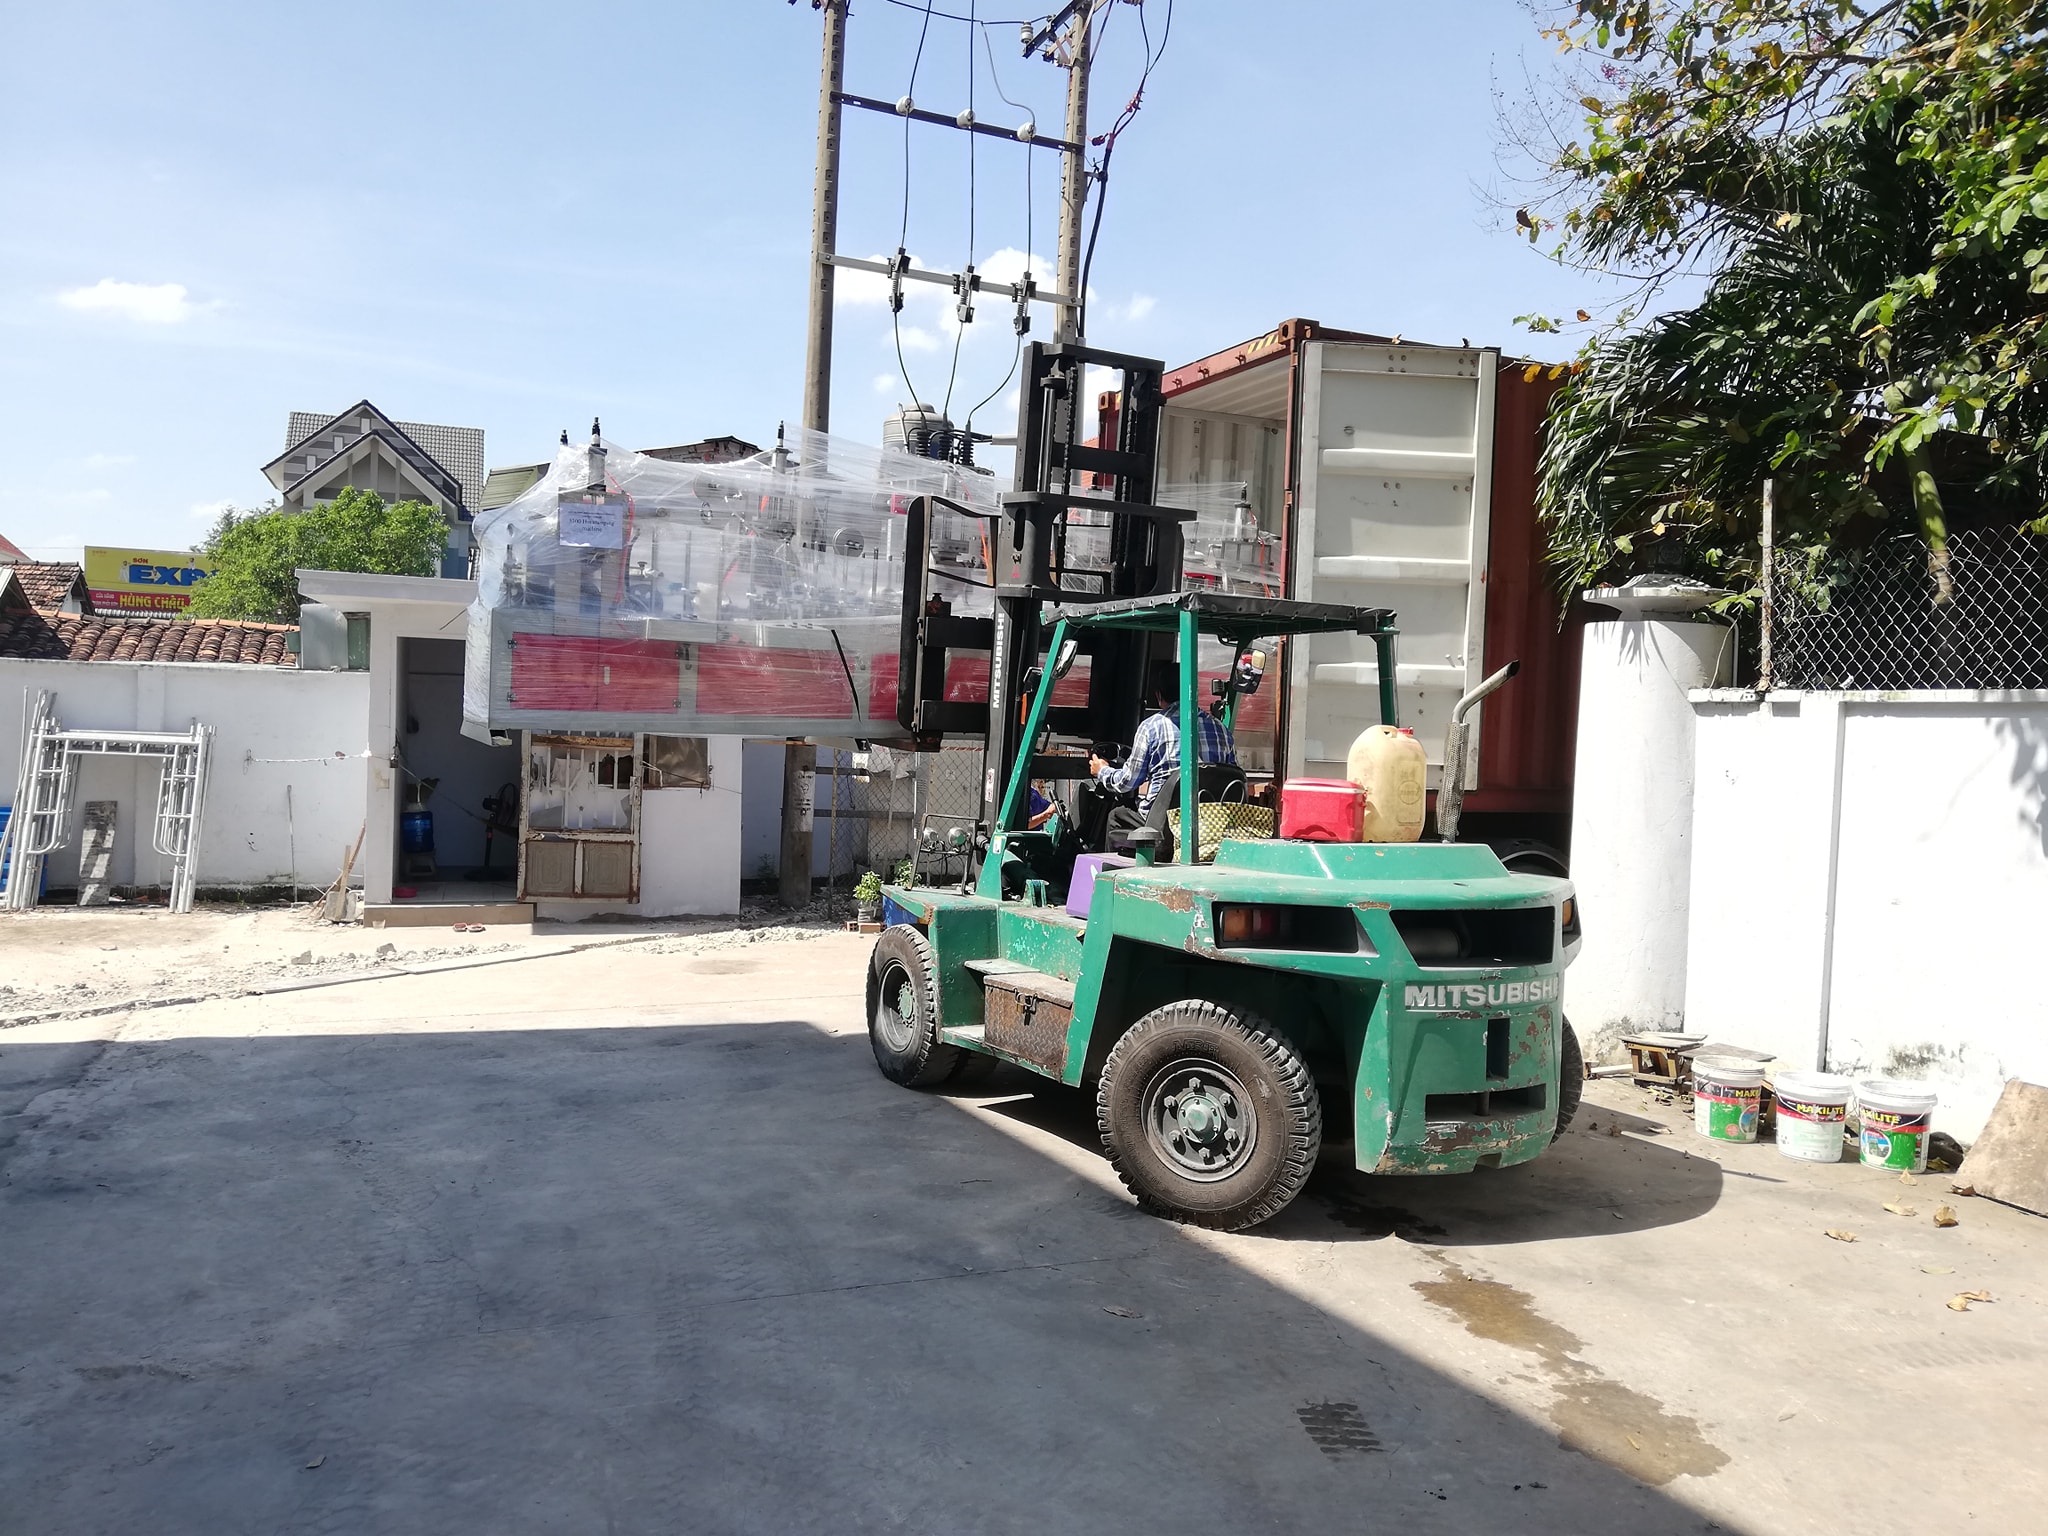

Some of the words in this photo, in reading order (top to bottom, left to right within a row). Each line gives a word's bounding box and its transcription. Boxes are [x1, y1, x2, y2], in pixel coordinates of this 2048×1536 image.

[129, 564, 220, 586] EXP
[993, 613, 1004, 708] MITSUBISHI
[1405, 976, 1559, 1007] MITSUBISHI
